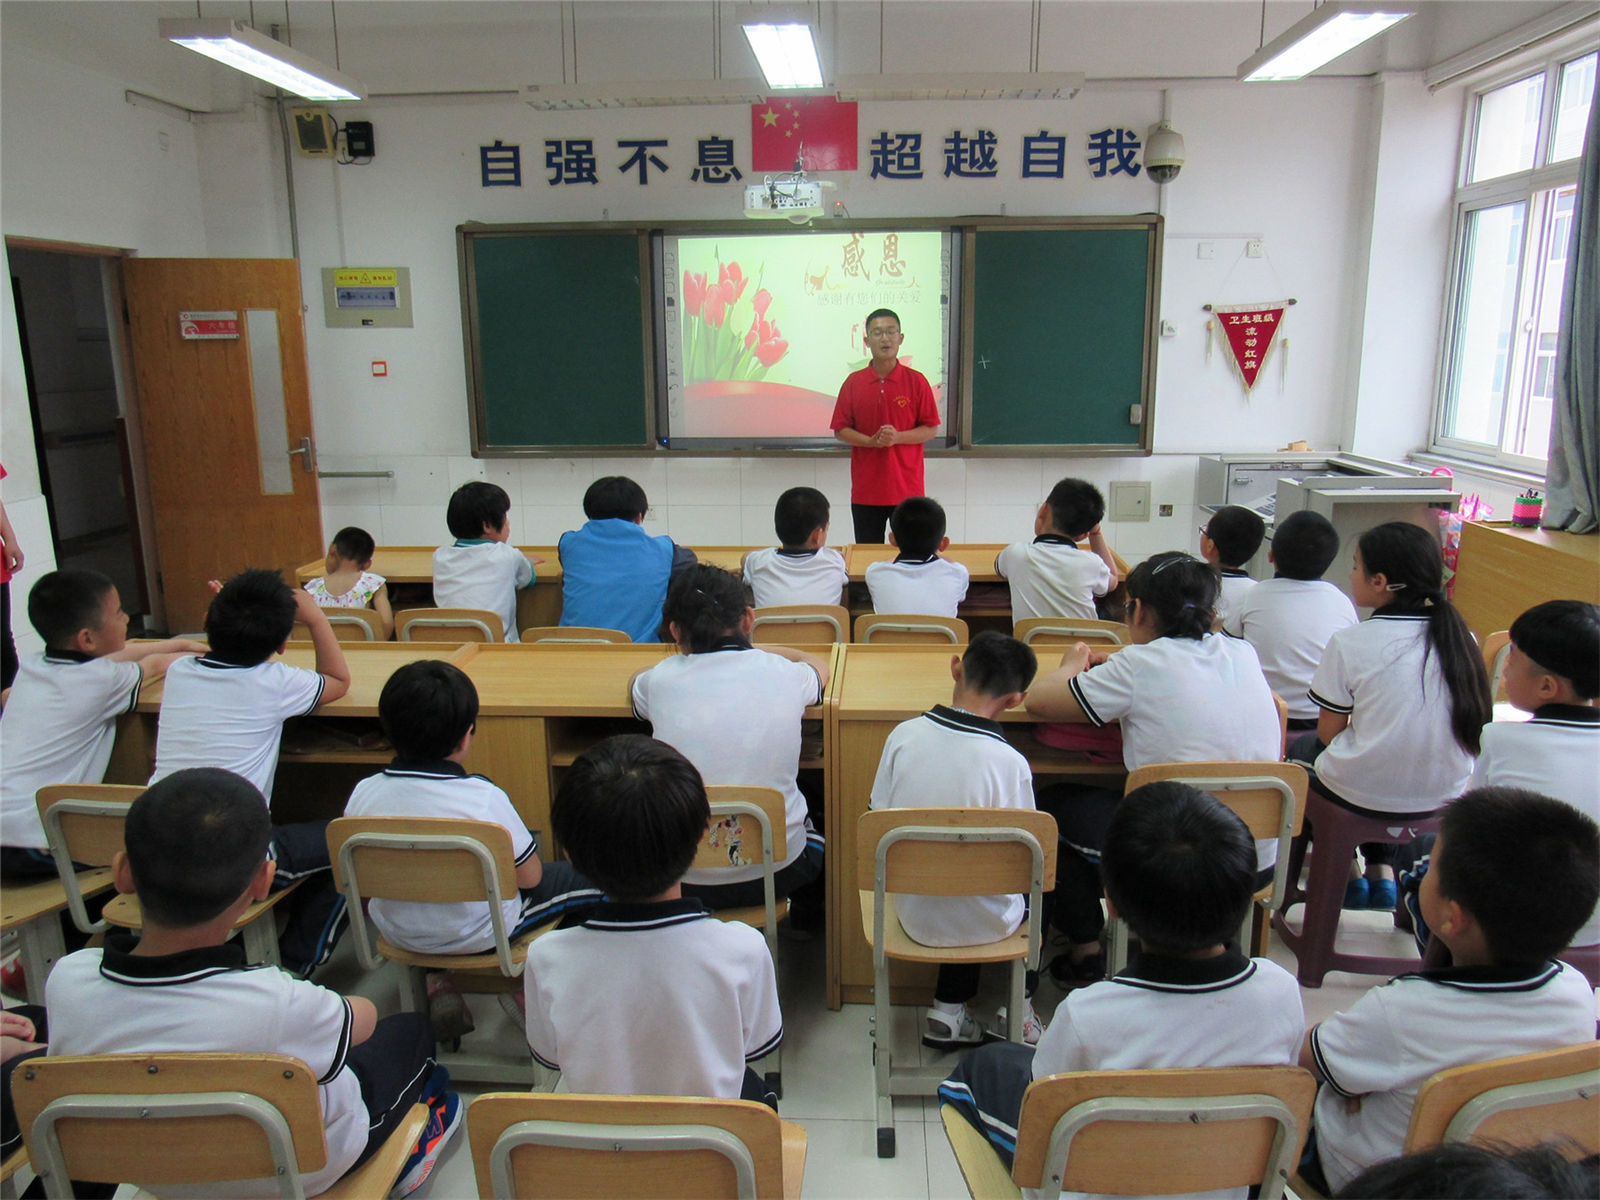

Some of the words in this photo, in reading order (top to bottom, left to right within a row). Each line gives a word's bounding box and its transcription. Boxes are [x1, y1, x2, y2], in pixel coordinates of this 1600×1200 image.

[479, 135, 743, 188] 自强不息
[869, 128, 1142, 180] 超越自我
[842, 232, 905, 280] 感恩
[1229, 313, 1274, 325] 卫生班级
[1244, 326, 1257, 369] 流动红旗
